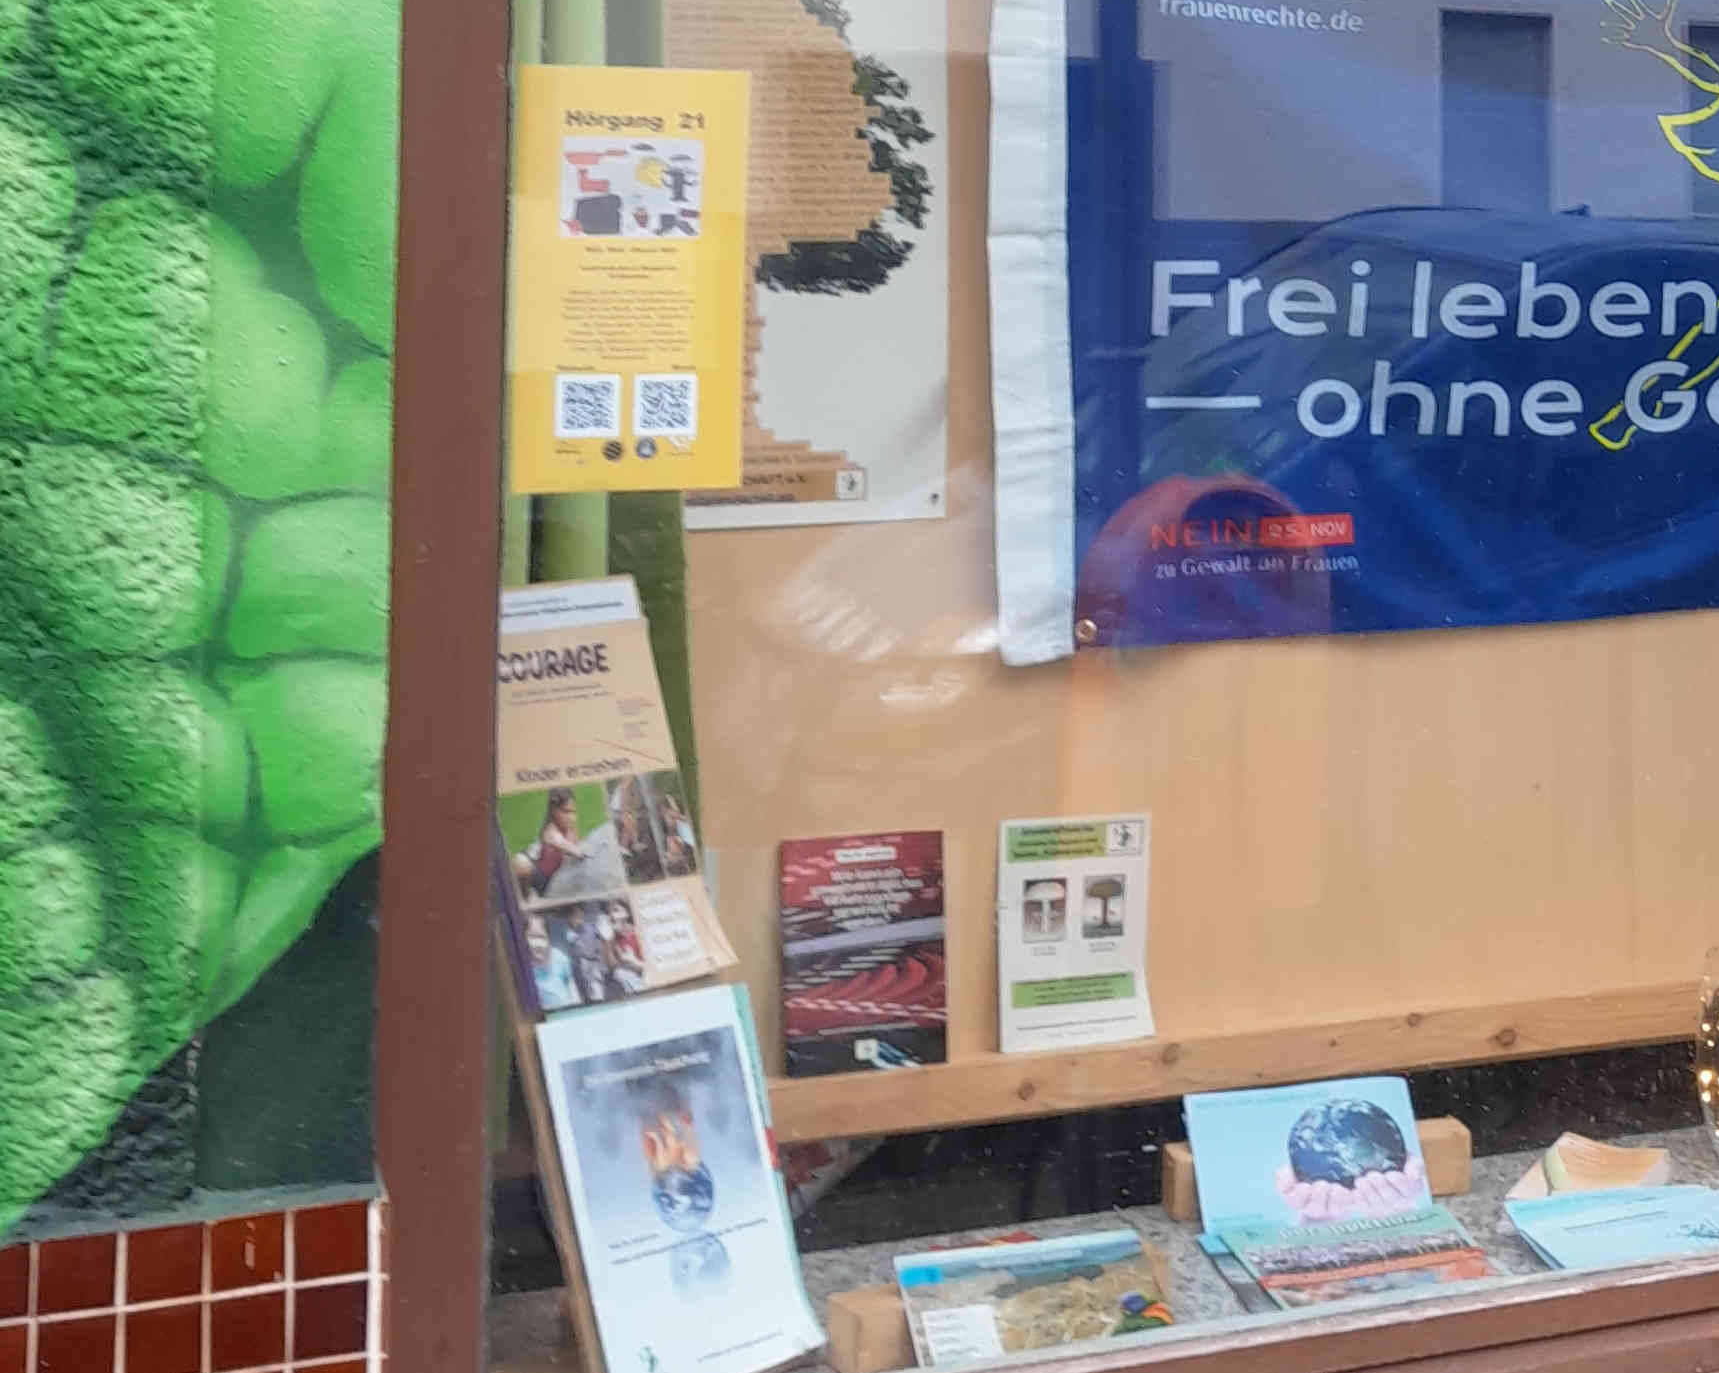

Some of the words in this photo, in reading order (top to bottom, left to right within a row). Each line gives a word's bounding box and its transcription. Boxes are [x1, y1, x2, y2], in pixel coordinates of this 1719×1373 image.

[1150, 260, 1370, 339] Frei
[1412, 261, 1719, 339] leben
[1295, 359, 1584, 438] ohne
[1151, 518, 1253, 549] NEIN
[1155, 564, 1177, 579] zu
[1181, 555, 1250, 575] Gewalt
[1291, 555, 1360, 572] Frauen
